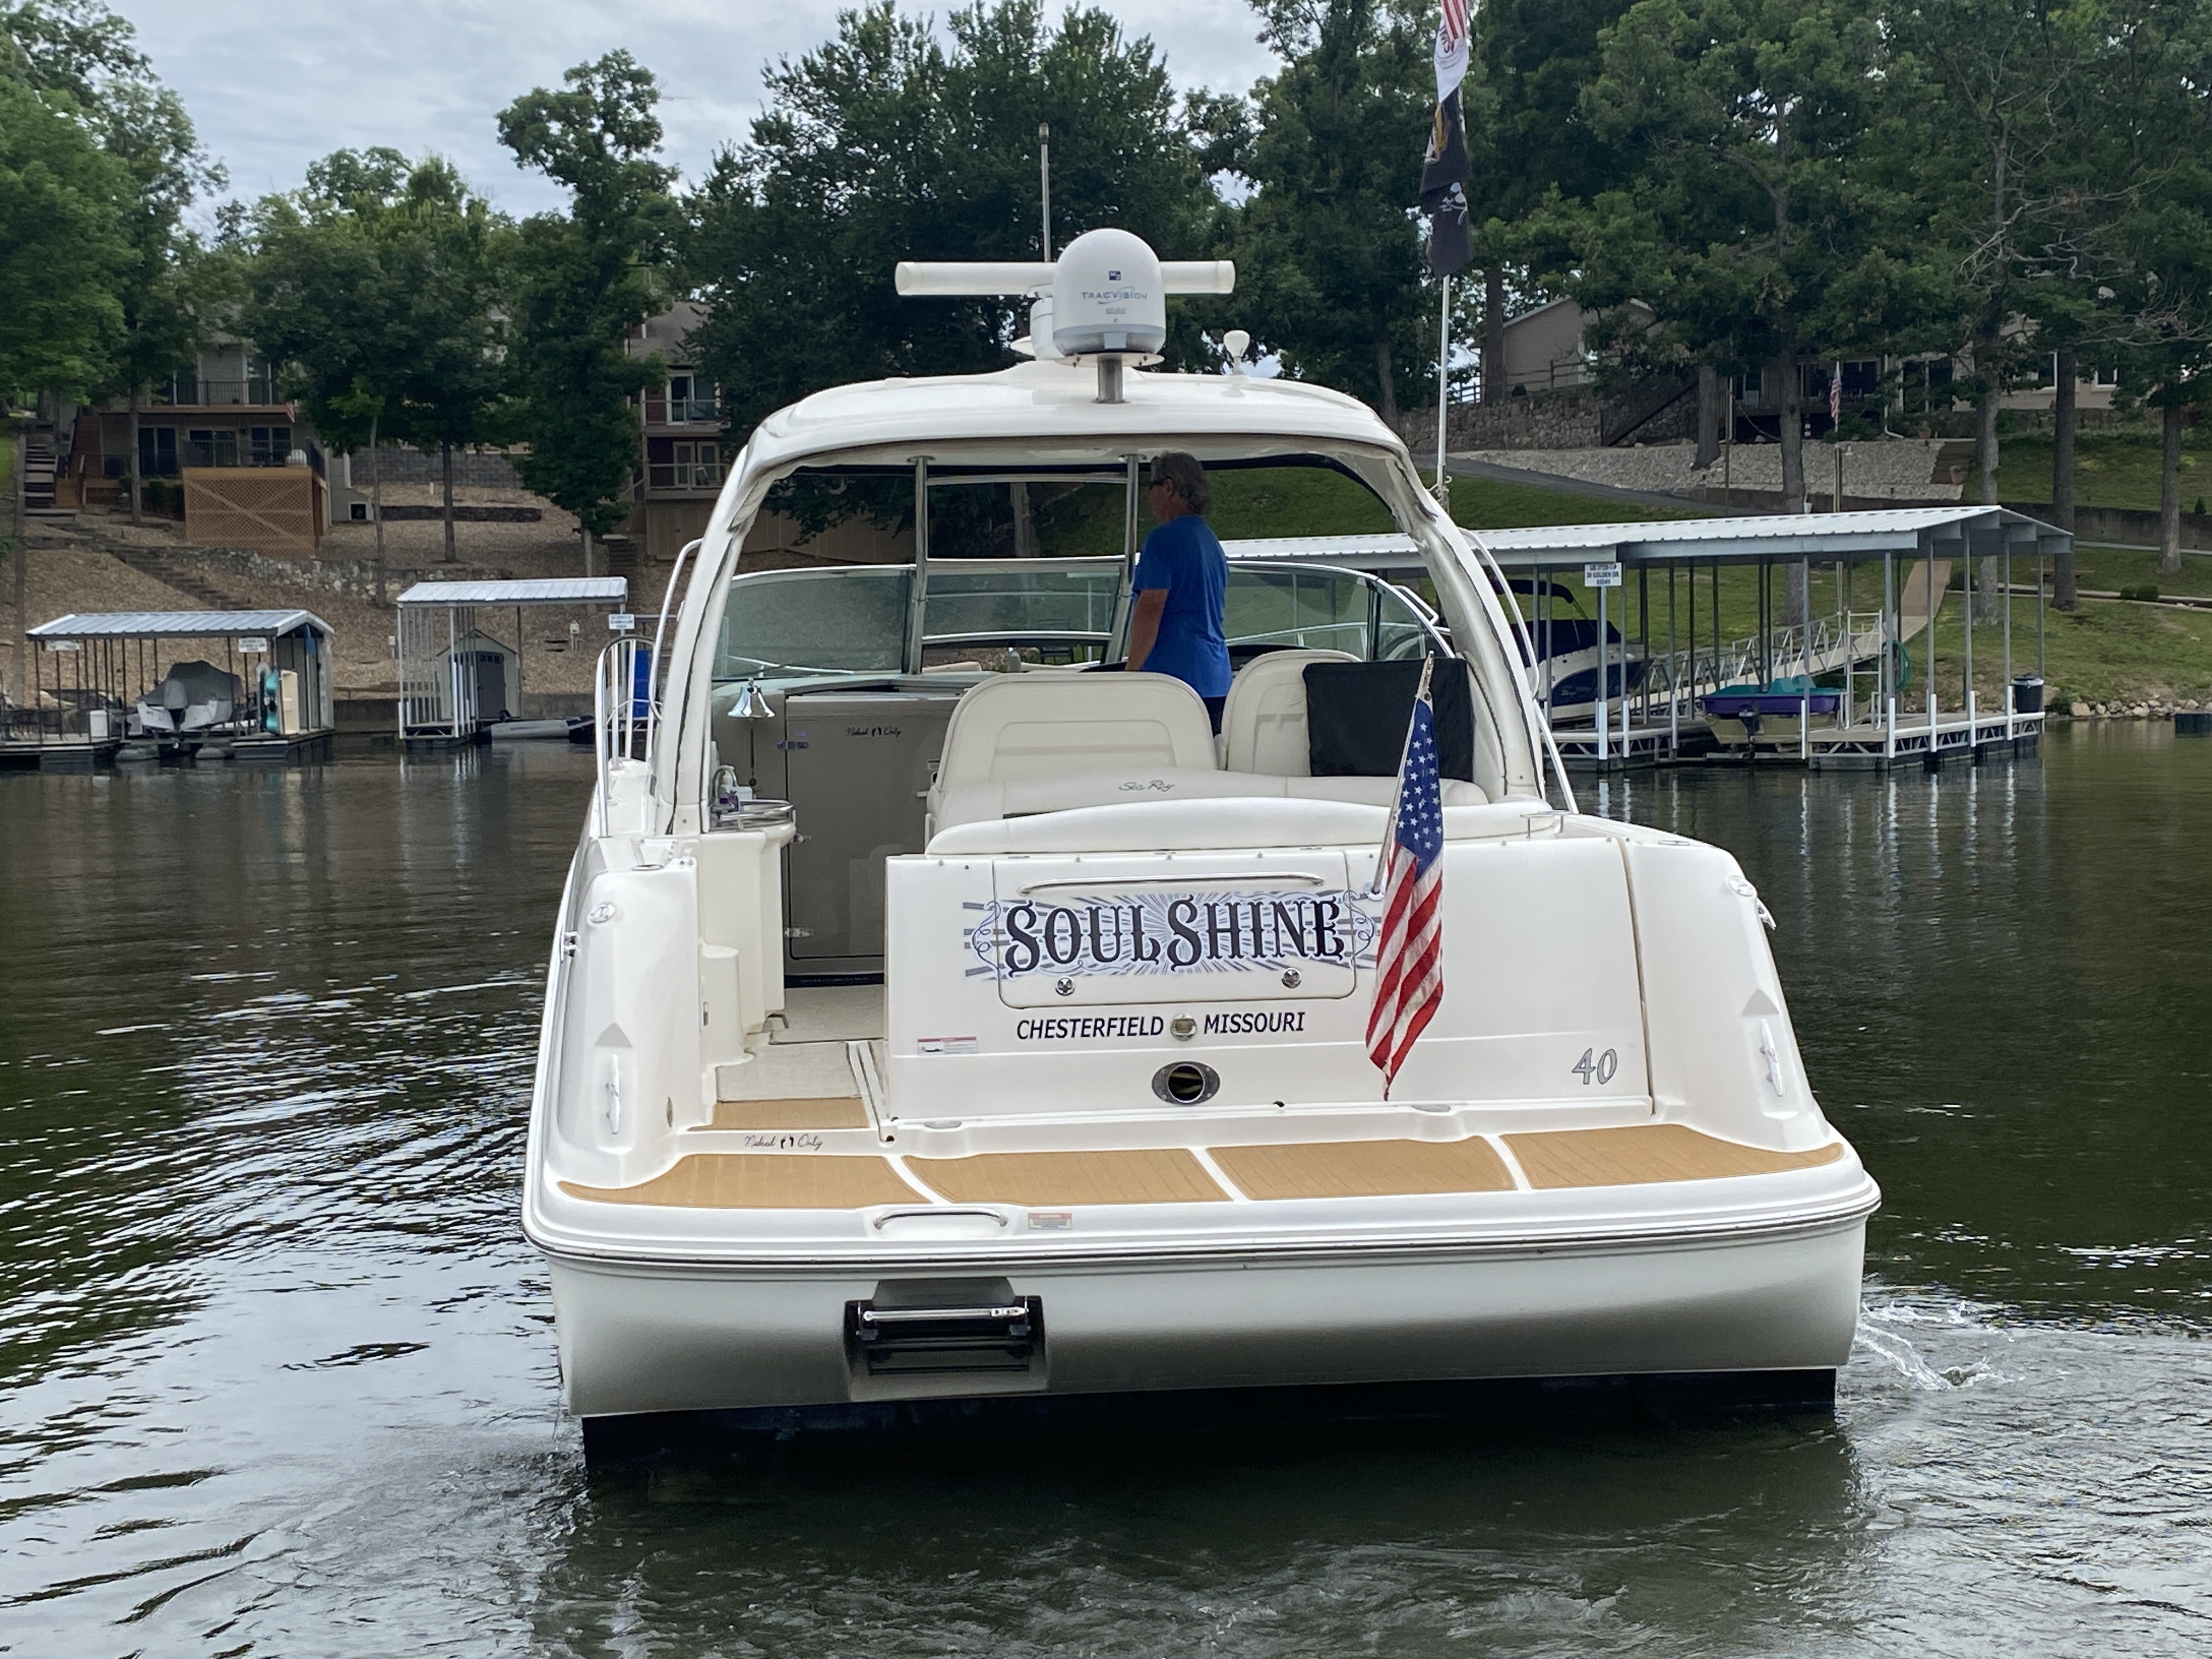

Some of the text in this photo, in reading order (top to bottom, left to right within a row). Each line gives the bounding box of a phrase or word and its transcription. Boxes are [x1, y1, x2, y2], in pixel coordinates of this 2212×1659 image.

[1118, 779, 1176, 792] Sea Ray
[1017, 1011, 1305, 1040] CHESTERFIELD MISSOURI
[1571, 1048, 1618, 1085] 40
[798, 1133, 823, 1152] Only
